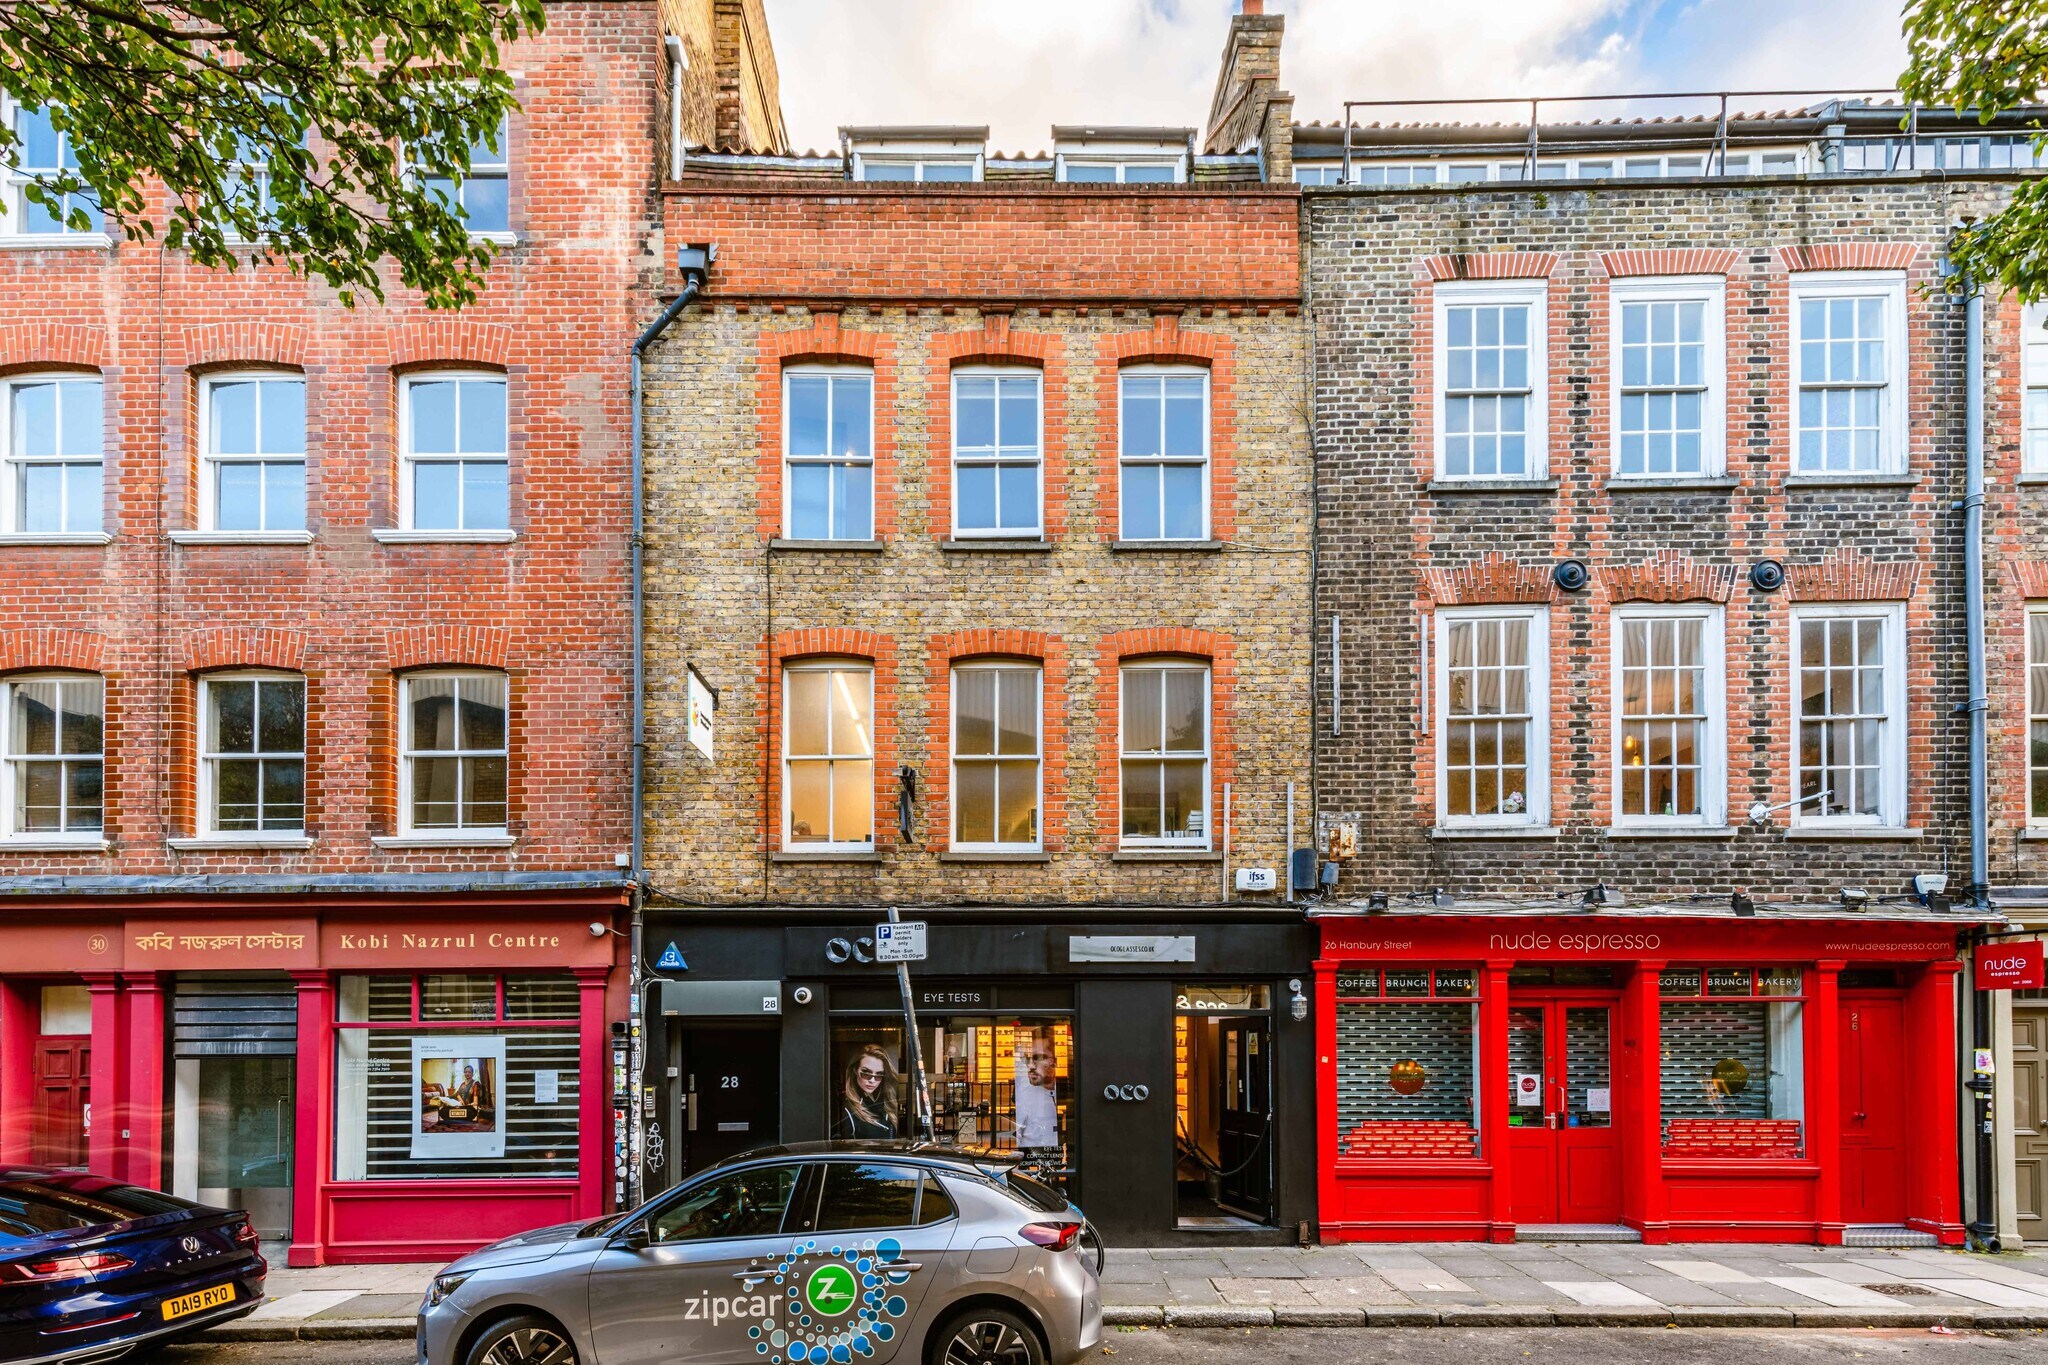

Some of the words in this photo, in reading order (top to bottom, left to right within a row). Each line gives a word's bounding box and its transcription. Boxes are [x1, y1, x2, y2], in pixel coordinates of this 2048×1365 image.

[1249, 871, 1265, 882] ifss
[91, 939, 105, 950] 30
[135, 932, 174, 951] কবি
[179, 935, 243, 950] নজরুল
[246, 932, 305, 950] সেন্টার
[340, 934, 388, 949] Kobi
[402, 933, 476, 948] Nazrul
[488, 932, 560, 948] Centre
[1325, 941, 1336, 949] 26
[1339, 940, 1382, 951] Hanbury
[1384, 940, 1412, 949] Street
[1490, 931, 1551, 950] nude
[1559, 934, 1661, 953] espresso
[1825, 942, 1950, 951] www.nudeespresso.com
[1984, 956, 2027, 970] nude
[1338, 979, 1377, 987] COFFEE
[1386, 979, 1427, 987] BRUNCH
[1436, 979, 1476, 987] BAKERY
[1658, 978, 1698, 986] COFFEE
[1707, 978, 1750, 986] BRUNCH
[1758, 978, 1799, 986] BAKERY
[924, 993, 944, 1002] EYE
[948, 993, 980, 1002] TESTS
[721, 1076, 739, 1088] 28
[1103, 1084, 1149, 1101] OCO
[171, 1295, 201, 1315] DA19
[204, 1287, 228, 1306] RYO
[684, 1289, 783, 1327] zipcar
